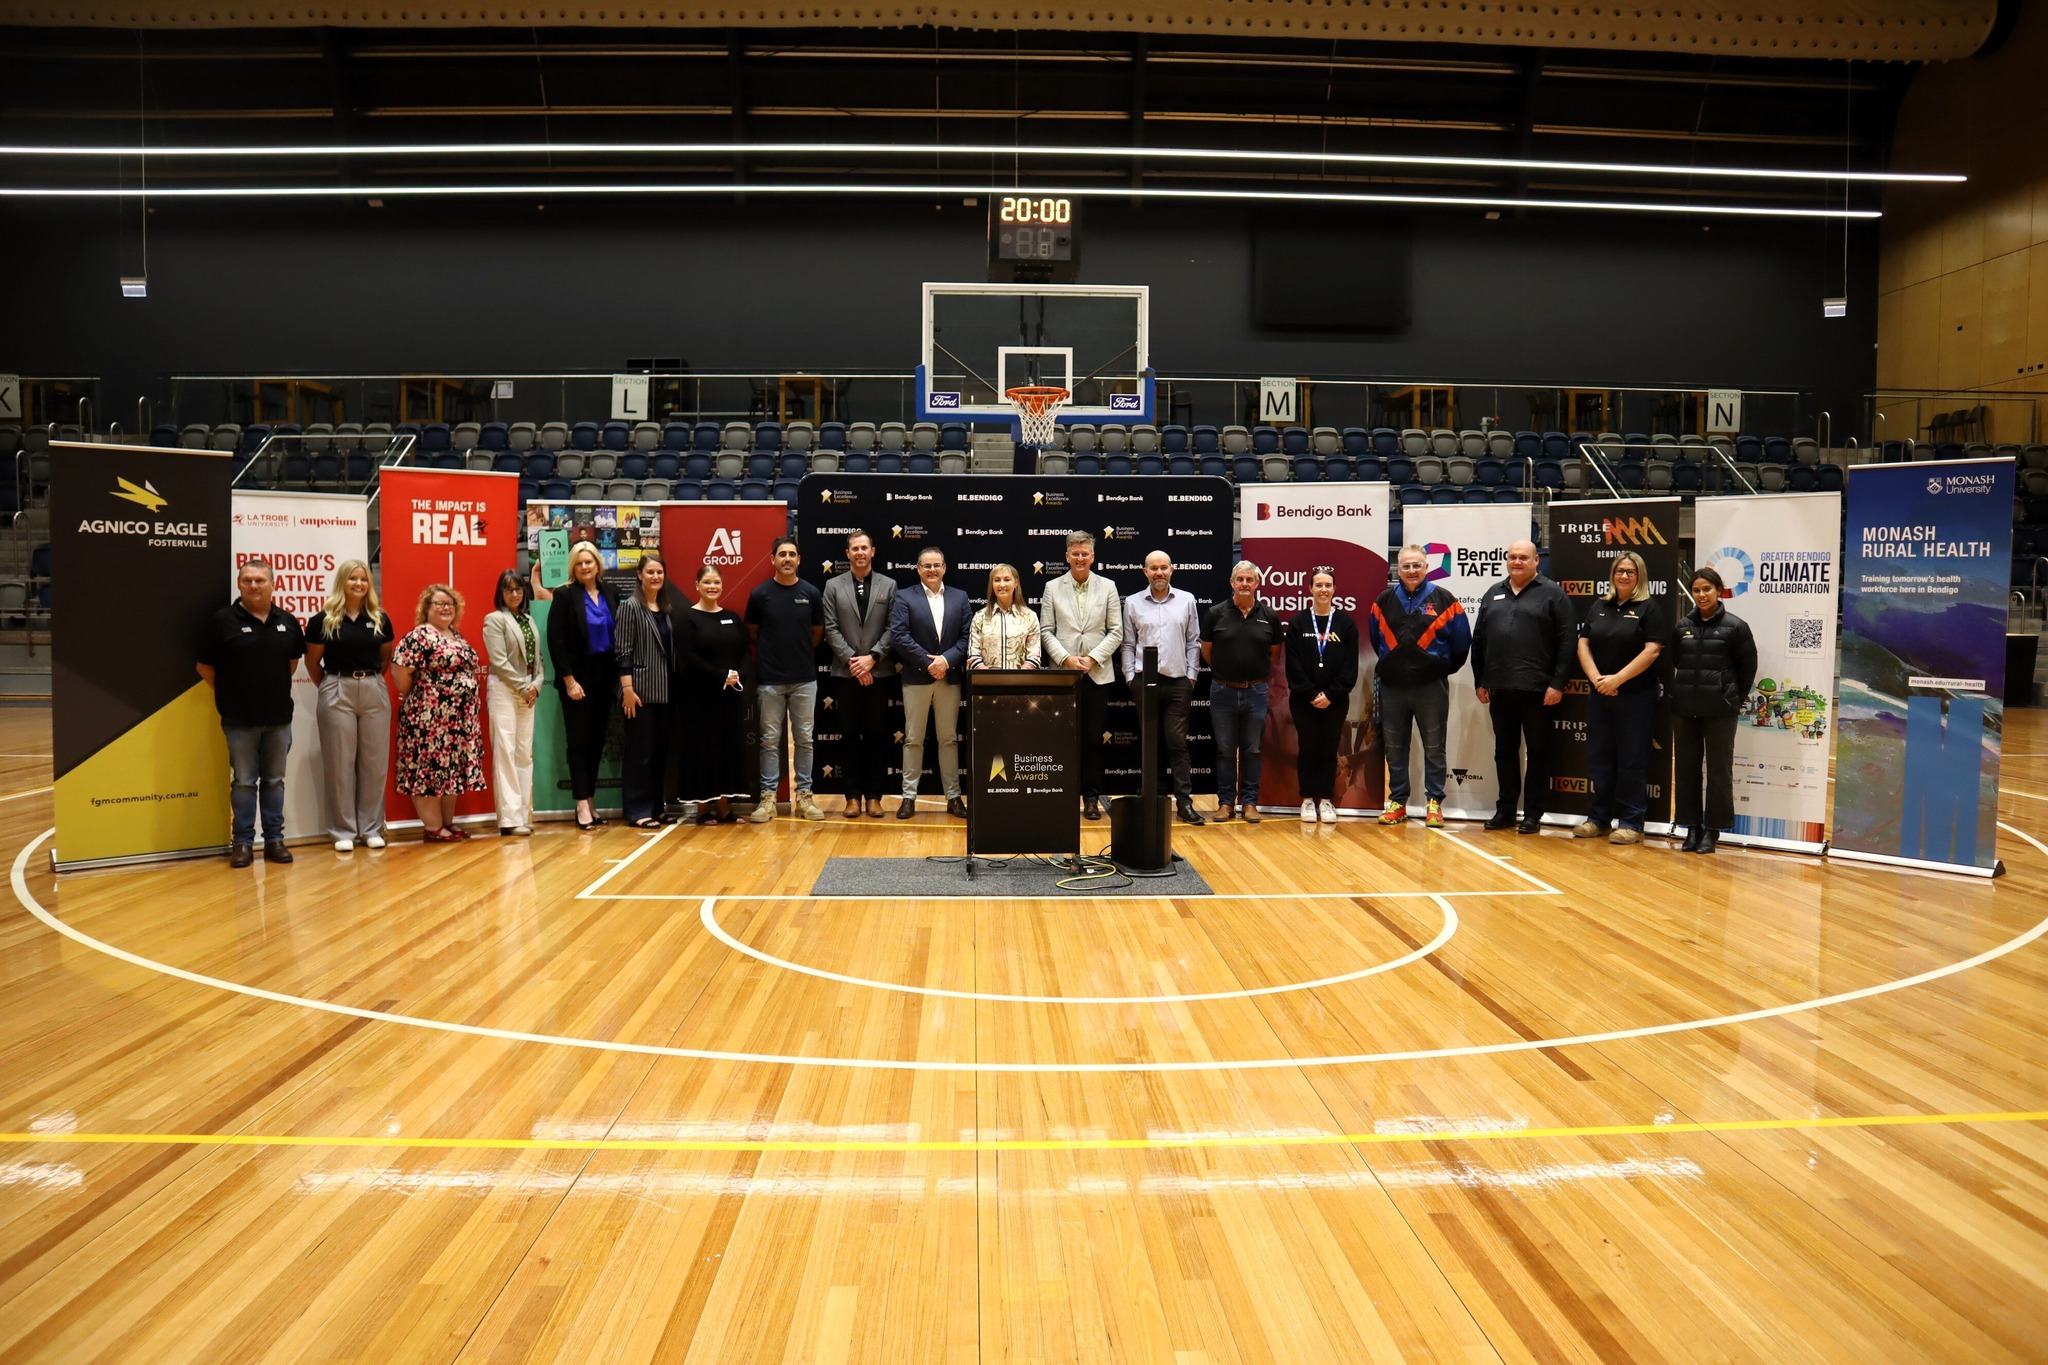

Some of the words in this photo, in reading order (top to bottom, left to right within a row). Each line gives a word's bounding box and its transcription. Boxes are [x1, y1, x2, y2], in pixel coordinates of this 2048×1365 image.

[1001, 197, 1071, 223] 20:00
[614, 377, 648, 385] SECTION
[624, 389, 637, 414] L
[931, 395, 957, 408] Ford
[1112, 396, 1139, 409] Ford
[1266, 391, 1290, 416] M
[1715, 403, 1734, 427] N
[1946, 475, 1995, 485] MONASH
[1946, 484, 1992, 495] University
[894, 493, 917, 501] Bendigo
[917, 493, 933, 501] Bank
[957, 494, 1003, 502] BE.BENDIGO
[411, 499, 432, 511] THE
[435, 500, 473, 512] IMPACT
[476, 502, 487, 512] IS
[1277, 505, 1333, 520] Bendigo
[1337, 504, 1372, 517] Bank
[299, 516, 357, 528] emporium
[78, 520, 150, 535] AGNICO
[154, 522, 208, 537] EAGLE
[412, 512, 487, 546] REAL
[1175, 529, 1198, 537] Bendigo
[1862, 525, 1937, 542] MONASH
[148, 538, 208, 548] FOSTERVILLE
[705, 527, 741, 555] Ai
[1580, 534, 1602, 543] 93.5
[1862, 543, 1917, 558] RURAL
[1924, 542, 1991, 557] HEALTH
[703, 556, 744, 566] GROUP
[1761, 552, 1794, 561] GREATER
[1796, 551, 1831, 561] BENDIGO
[1105, 563, 1128, 571] Bendigo
[1457, 563, 1502, 577] TAFE
[1759, 562, 1831, 582] CLIMATE
[1256, 566, 1307, 586] Your
[1861, 575, 1891, 584] Training
[1892, 575, 1935, 583] tomorrow's
[1936, 575, 1961, 583] health
[1759, 583, 1830, 594] COLLABORATION
[1926, 586, 1959, 595] Bendigo
[967, 597, 988, 605] endigo
[1257, 590, 1357, 611] businss
[1911, 679, 1984, 688] monash.edu/rural-health
[1552, 720, 1588, 731] TRIP
[1014, 754, 1053, 763] Business
[1014, 763, 1064, 772] Excellence
[1104, 768, 1128, 776] Bendigo
[1014, 772, 1049, 781] Awards
[91, 791, 199, 807] fgmcommunity.com.au
